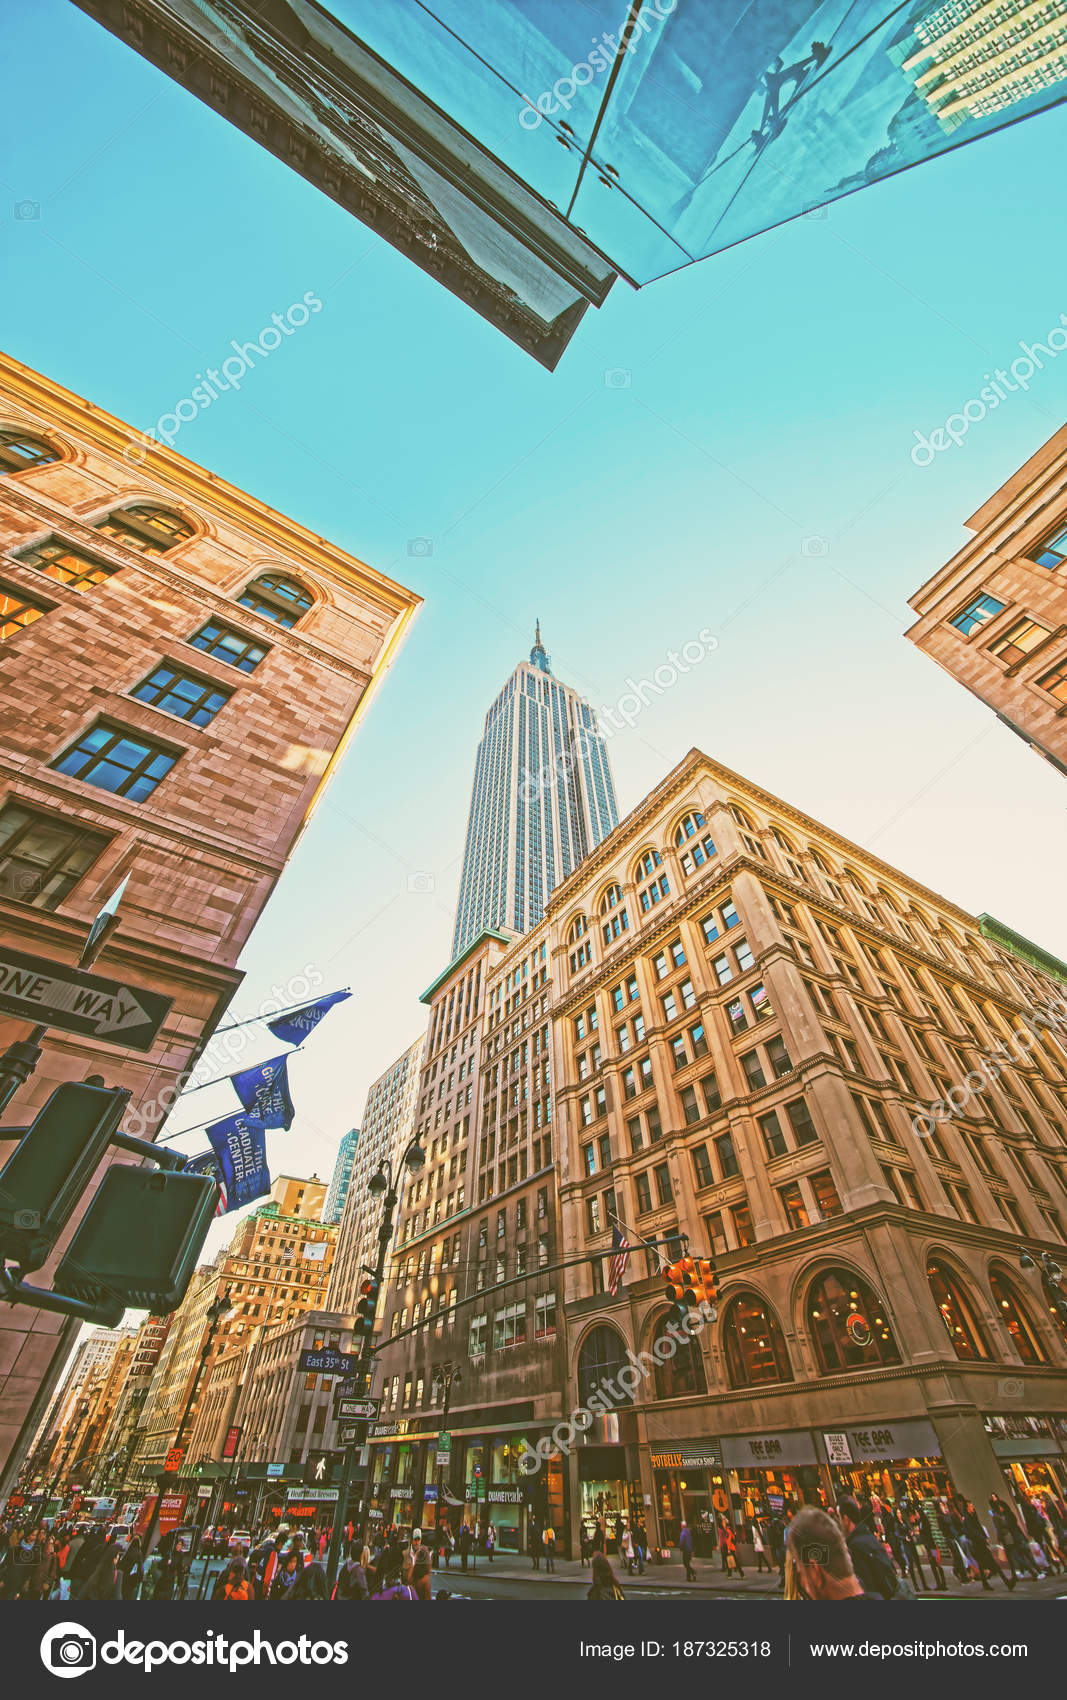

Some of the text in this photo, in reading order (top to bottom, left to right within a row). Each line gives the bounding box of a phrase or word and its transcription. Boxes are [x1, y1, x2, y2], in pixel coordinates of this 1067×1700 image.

[72, 990, 138, 1024] WAY
[227, 1135, 244, 1182] CENTER
[254, 1148, 263, 1173] THE
[306, 1355, 323, 1368] East
[341, 1359, 350, 1370] St
[345, 1404, 374, 1414] ONE WAY
[169, 1451, 180, 1462] 20
[651, 1453, 682, 1469] POTBELLY
[703, 1456, 715, 1465] SHOP
